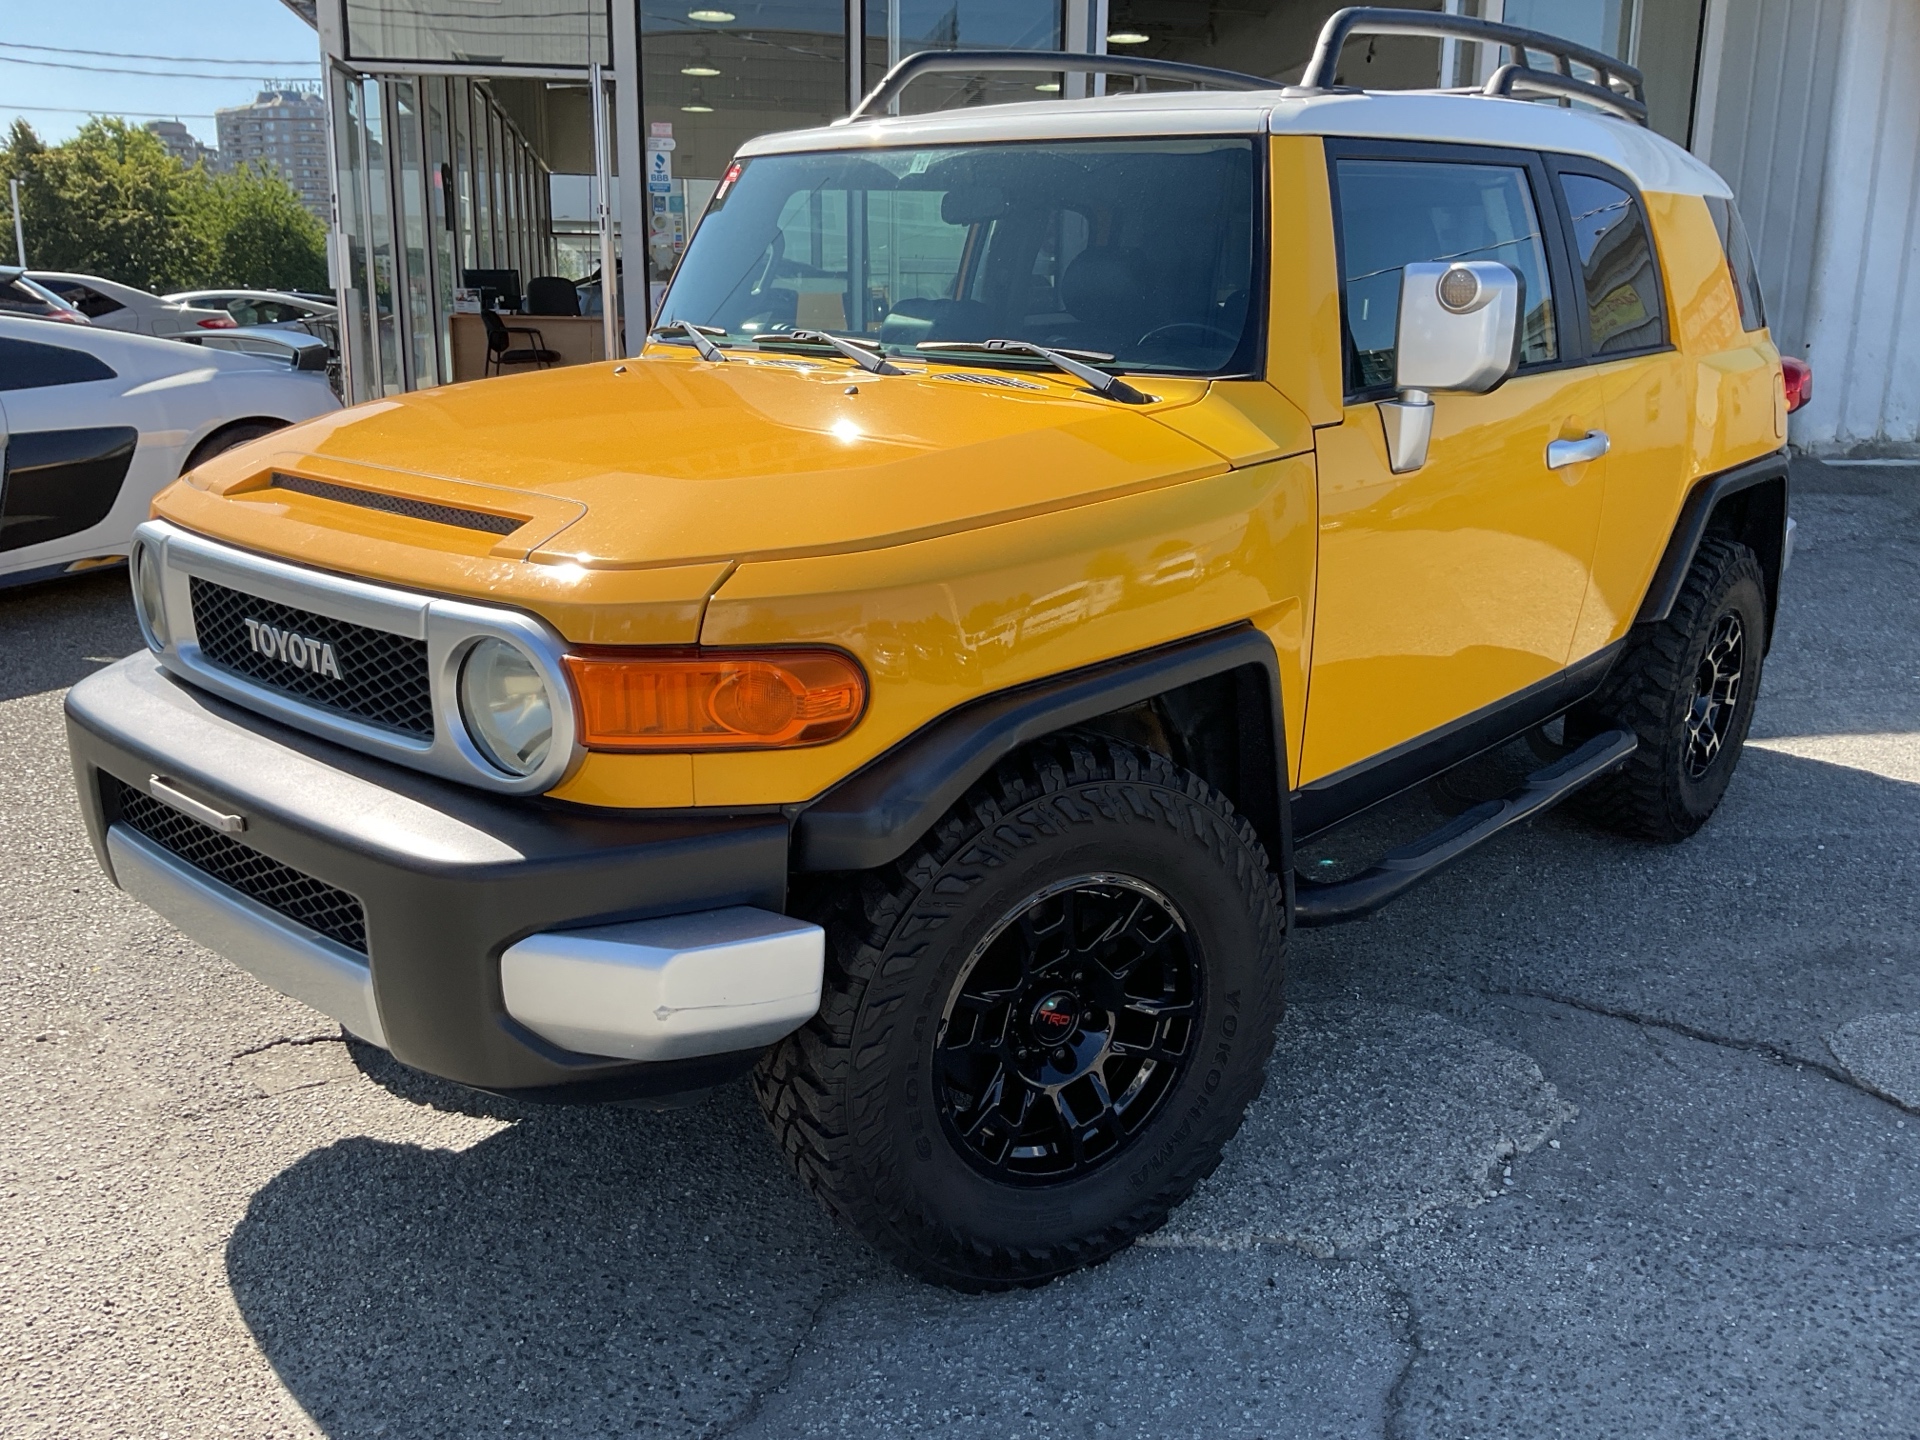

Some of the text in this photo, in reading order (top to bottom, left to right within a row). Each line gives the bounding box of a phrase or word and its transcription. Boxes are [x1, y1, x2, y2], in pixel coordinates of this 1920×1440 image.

[651, 174, 669, 182] BBB
[245, 618, 341, 680] TOYOTA
[1040, 1010, 1070, 1026] TRD
[1129, 989, 1242, 1192] YOKOHAMA
